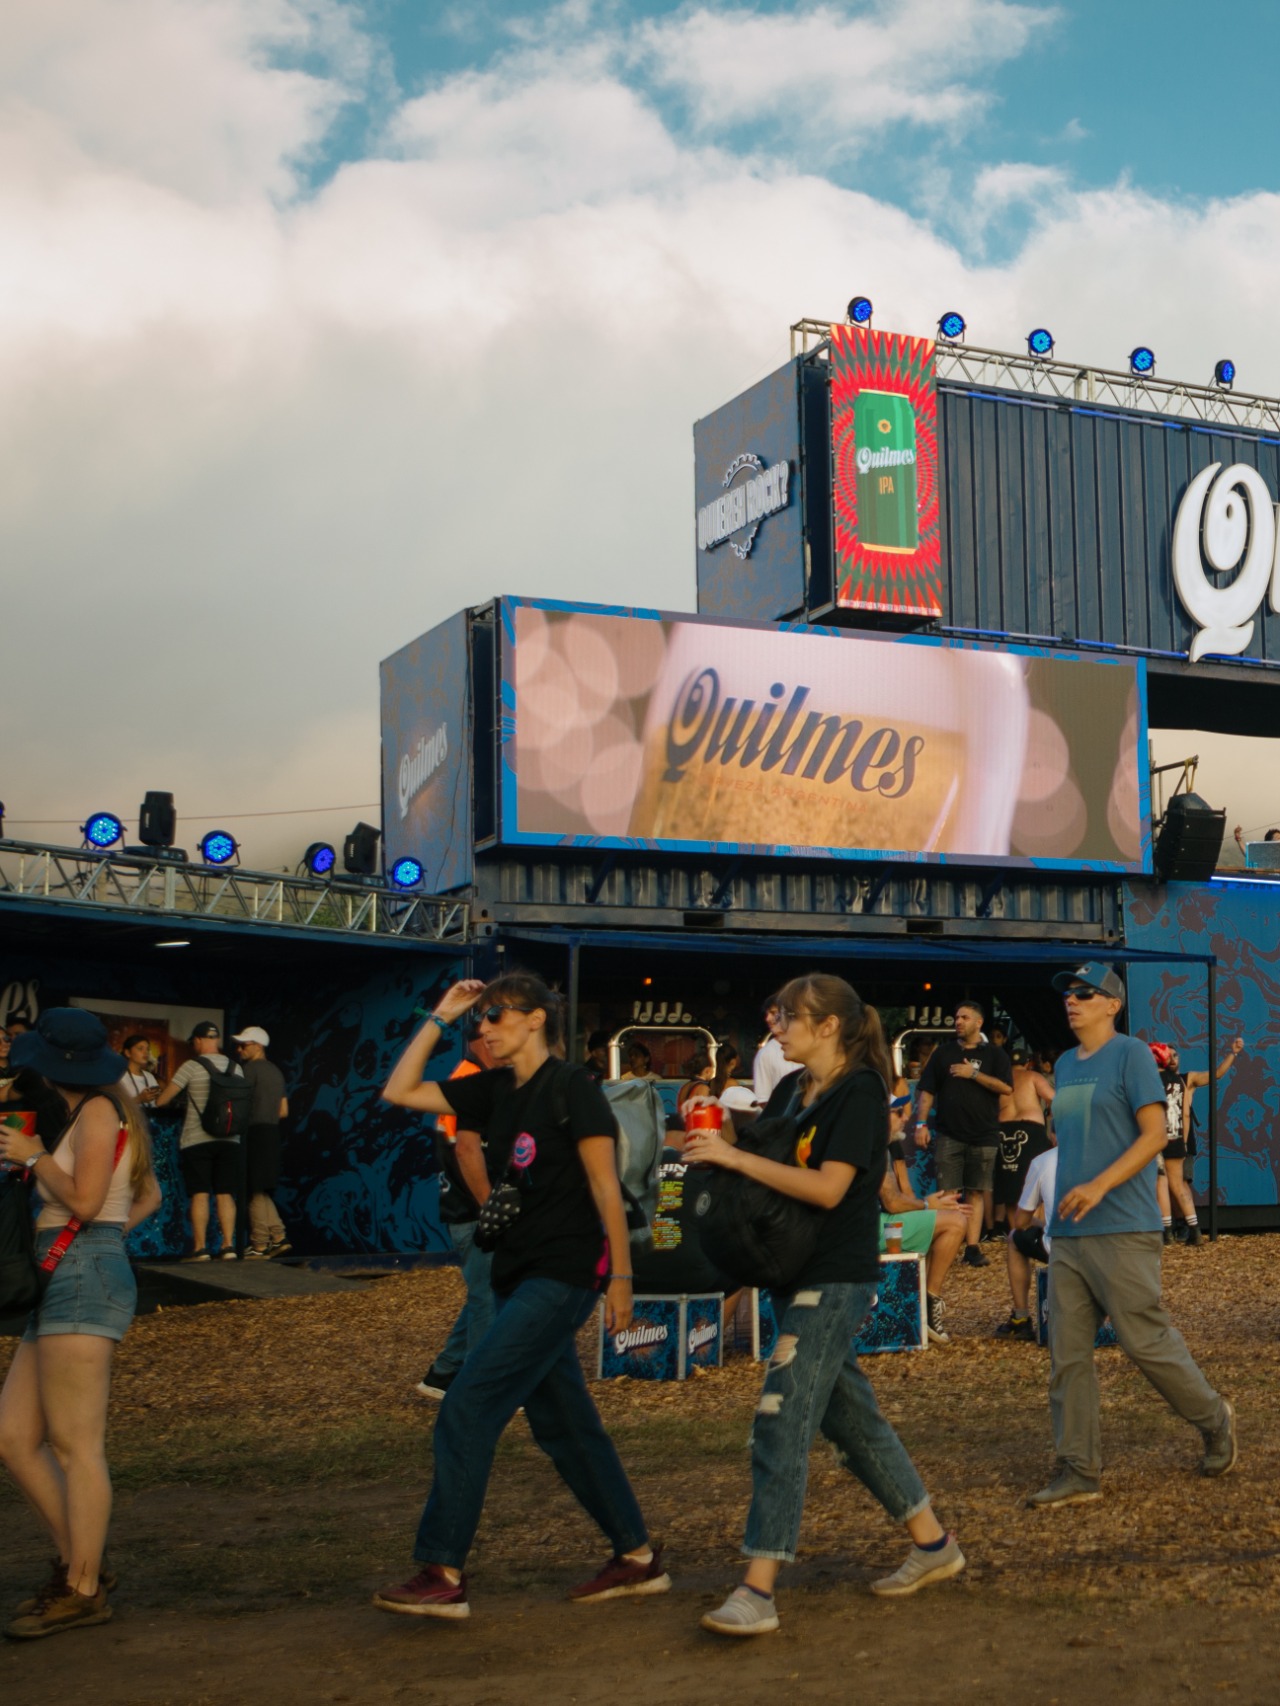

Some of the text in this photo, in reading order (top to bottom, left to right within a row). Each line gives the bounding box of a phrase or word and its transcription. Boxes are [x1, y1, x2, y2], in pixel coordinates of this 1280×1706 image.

[856, 446, 915, 474] Quilmes
[746, 460, 789, 523] ROCK?
[879, 476, 895, 494] IPA
[661, 667, 925, 799] Quilmes
[398, 722, 448, 819] Quilmes
[770, 785, 869, 813] ARGENTINA
[615, 1324, 668, 1355] Quilmes
[688, 1322, 718, 1354] Quilmes
